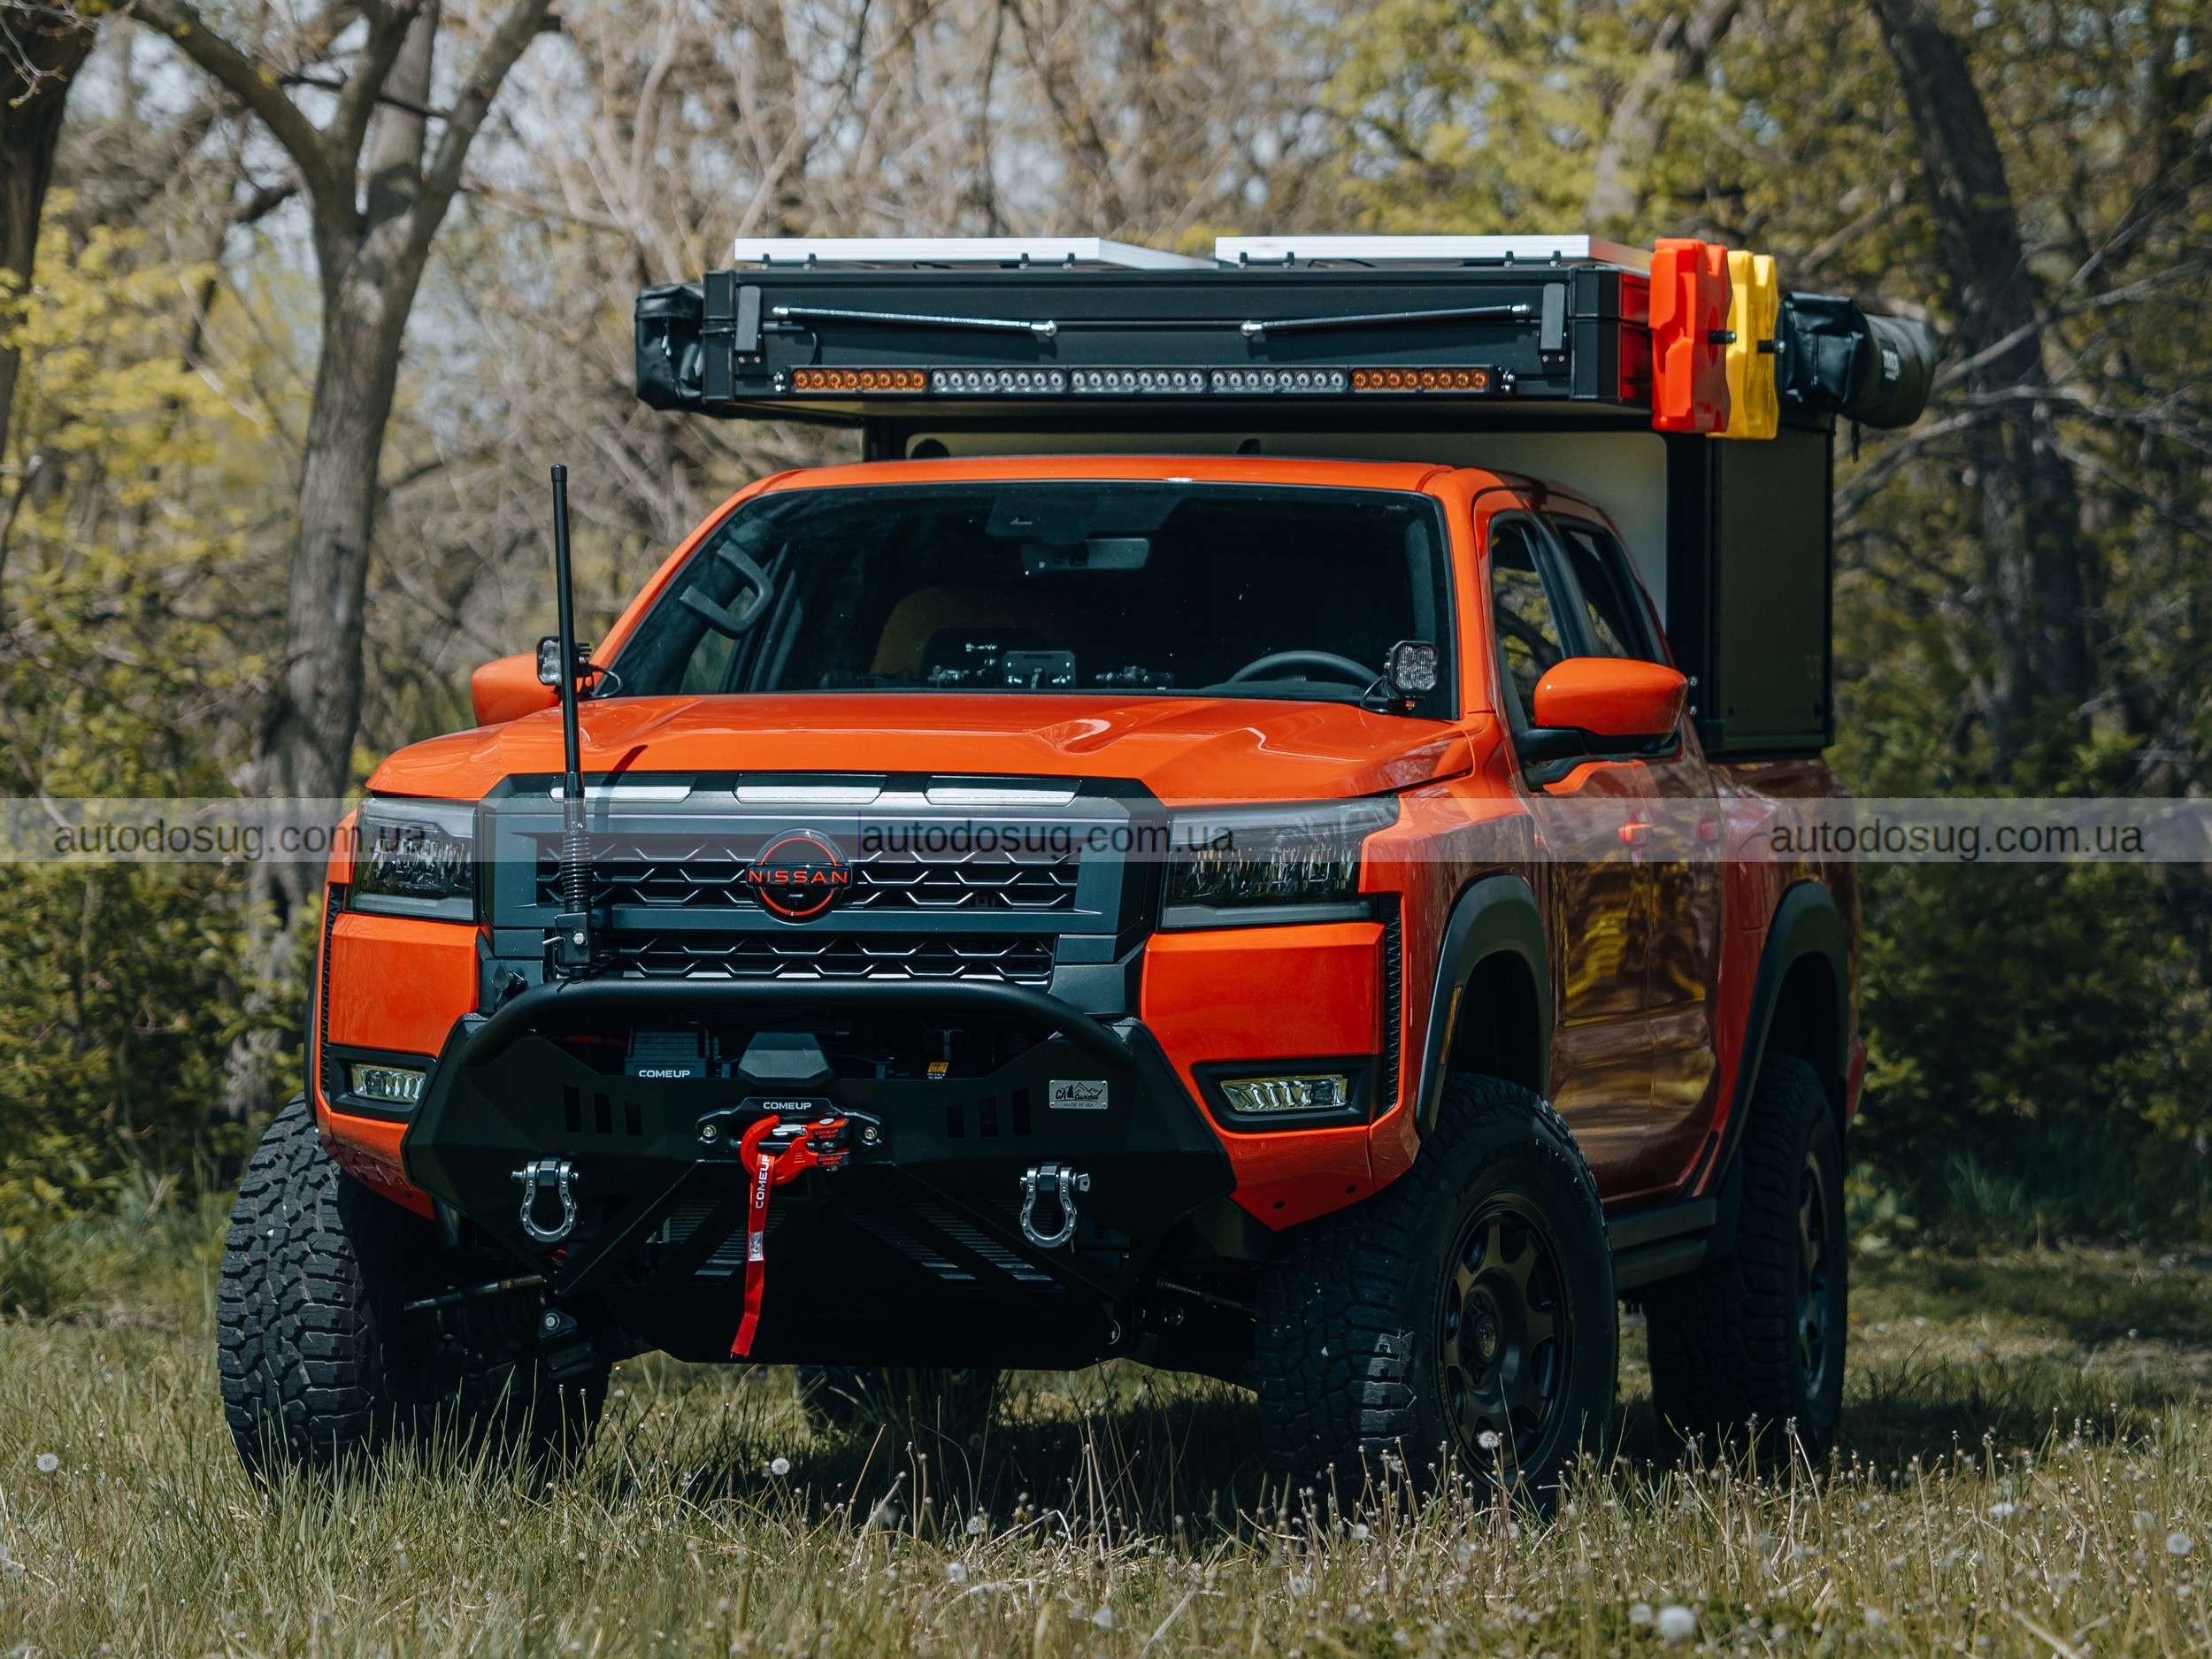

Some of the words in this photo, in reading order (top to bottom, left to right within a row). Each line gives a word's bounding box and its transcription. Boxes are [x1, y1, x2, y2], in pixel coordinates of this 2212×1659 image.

[748, 870, 848, 884] NISSAN
[638, 1070, 691, 1079] COMEUP
[763, 1102, 812, 1110] COMEUP
[755, 1153, 771, 1209] COMEUP
